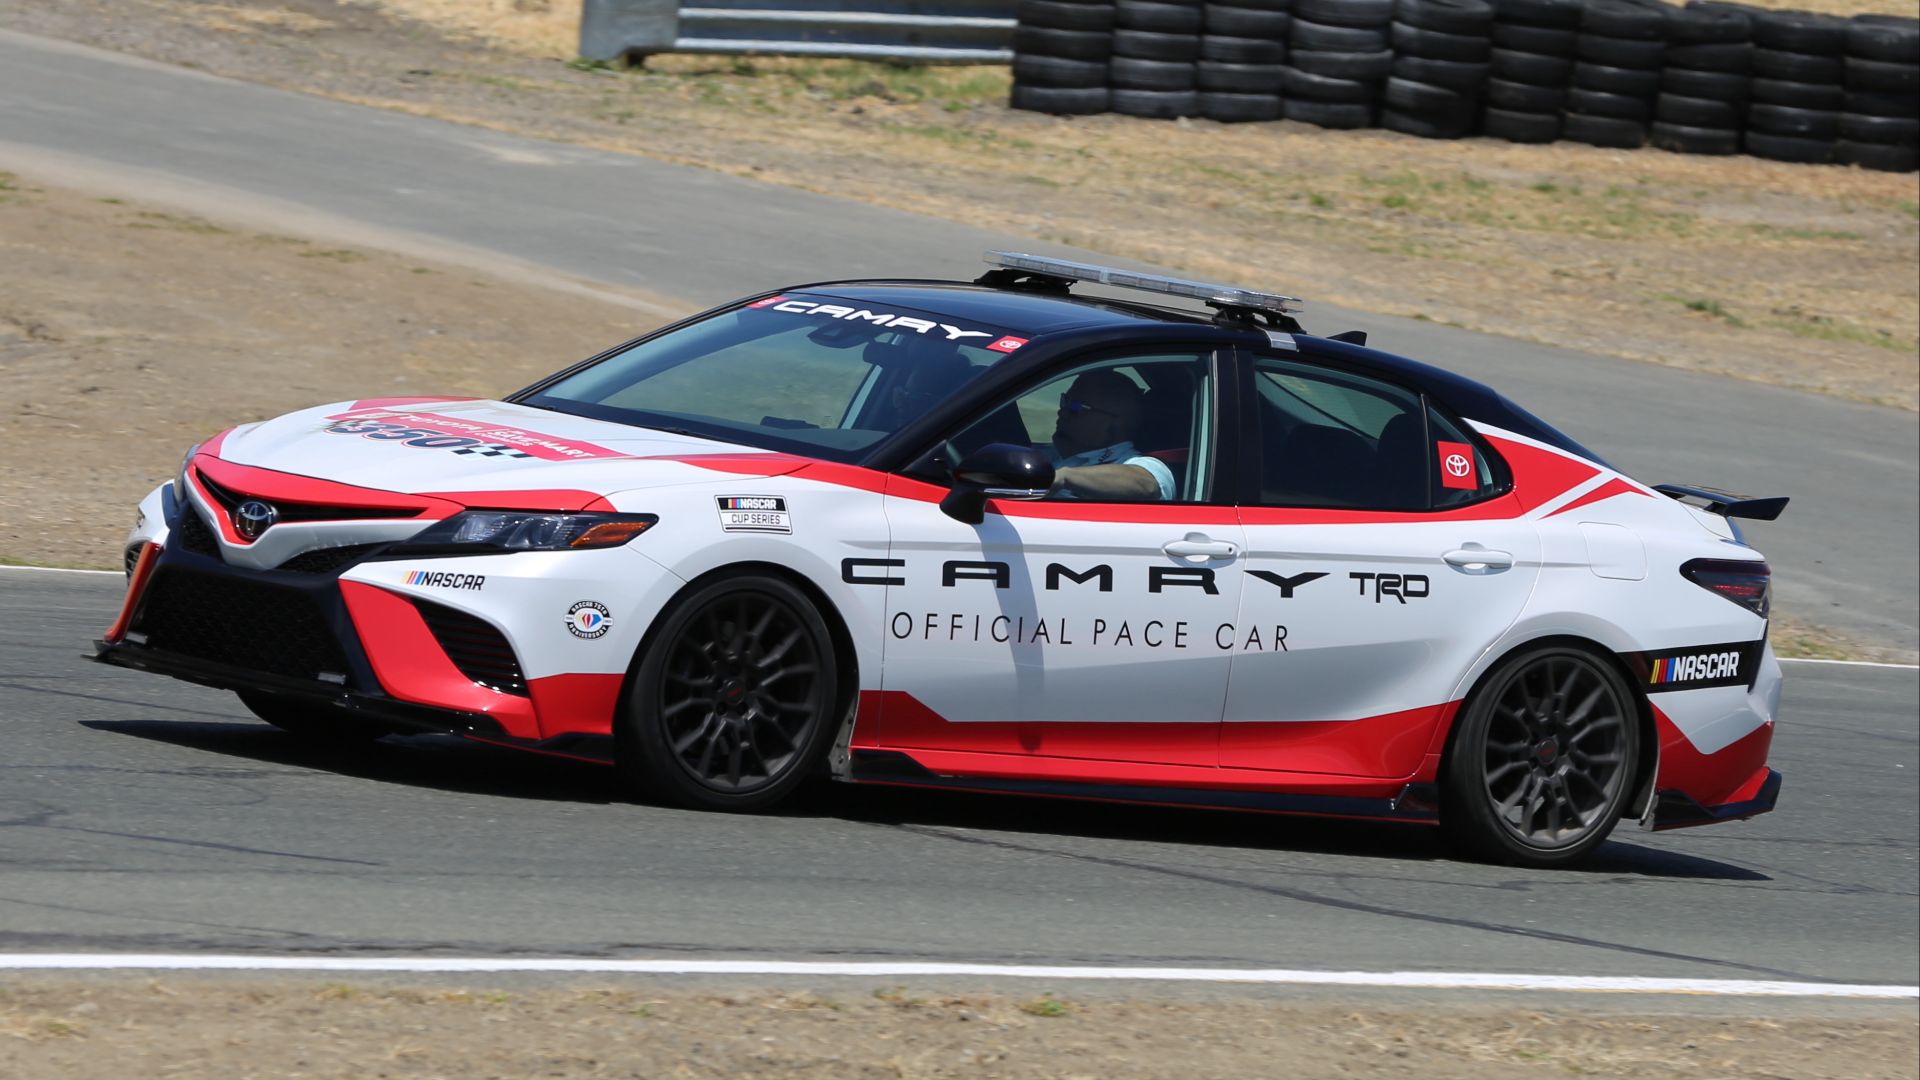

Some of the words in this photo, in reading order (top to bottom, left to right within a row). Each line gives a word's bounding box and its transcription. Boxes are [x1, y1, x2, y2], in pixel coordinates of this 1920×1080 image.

[773, 300, 993, 340] CAMRY
[325, 422, 484, 448] 350
[399, 415, 483, 431] TOYOTA
[740, 498, 777, 510] NASCAR
[731, 514, 749, 524] CUP
[750, 514, 781, 525] SERIES
[420, 571, 486, 591] NASCAR
[841, 557, 1331, 598] CAMRY
[1349, 571, 1430, 604] TRD
[891, 611, 1072, 645] OFFICIAL
[1093, 618, 1188, 648] PACE
[1215, 622, 1289, 652] CAR
[1673, 651, 1740, 682] NASCAR
